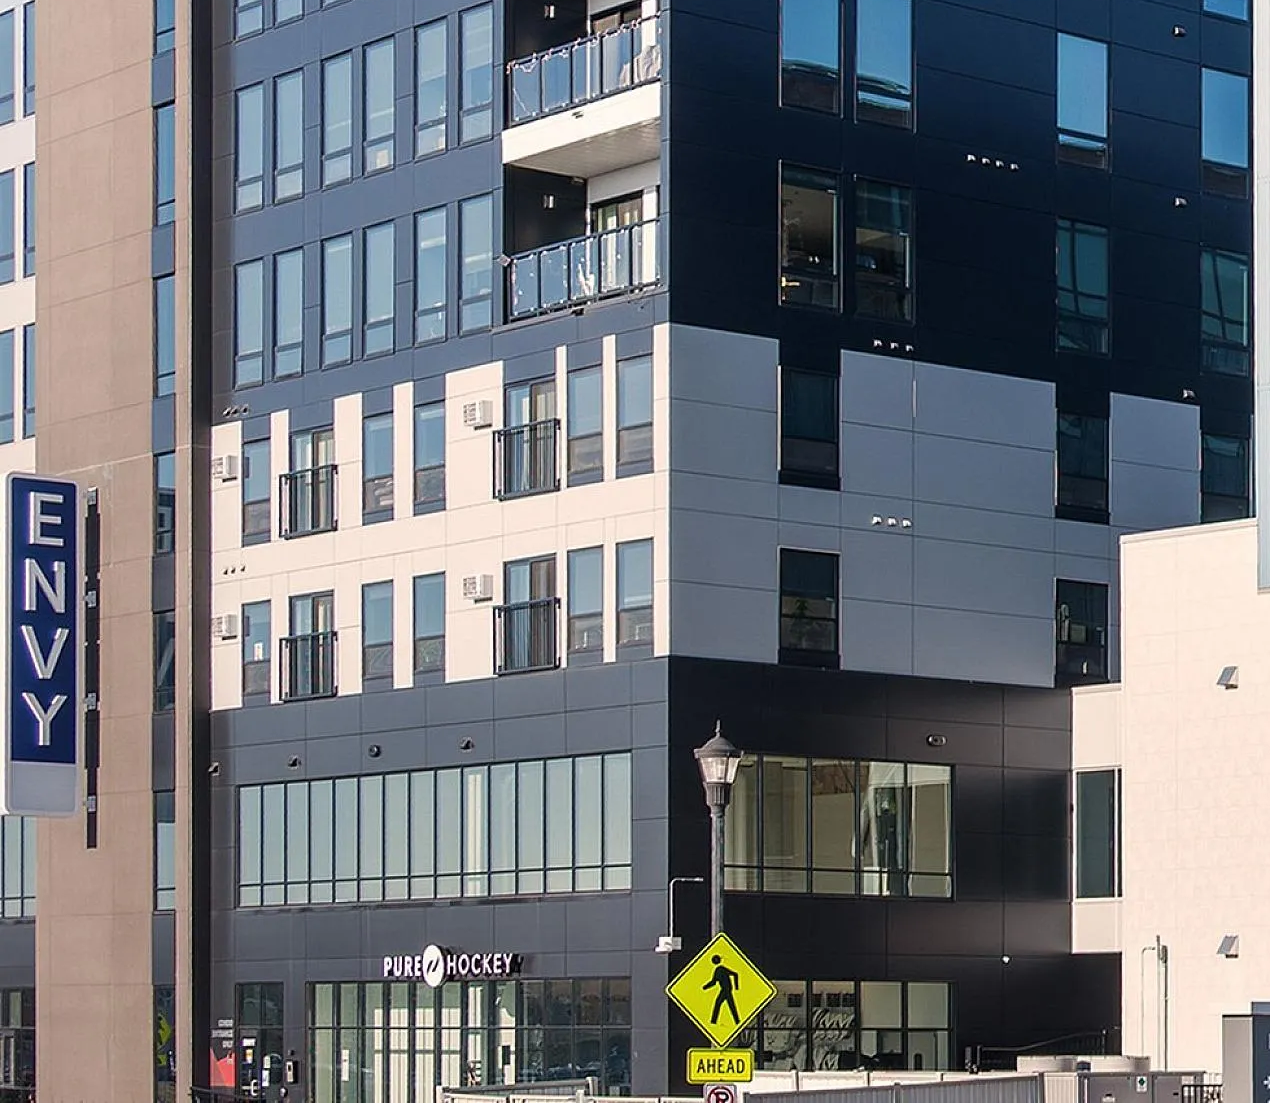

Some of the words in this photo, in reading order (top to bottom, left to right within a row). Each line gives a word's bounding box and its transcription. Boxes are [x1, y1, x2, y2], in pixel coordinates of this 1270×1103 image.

[22, 491, 70, 746] ENVY
[383, 955, 422, 977] PURE
[447, 953, 513, 975] HOCKEY
[697, 1058, 745, 1074] AHEAD
